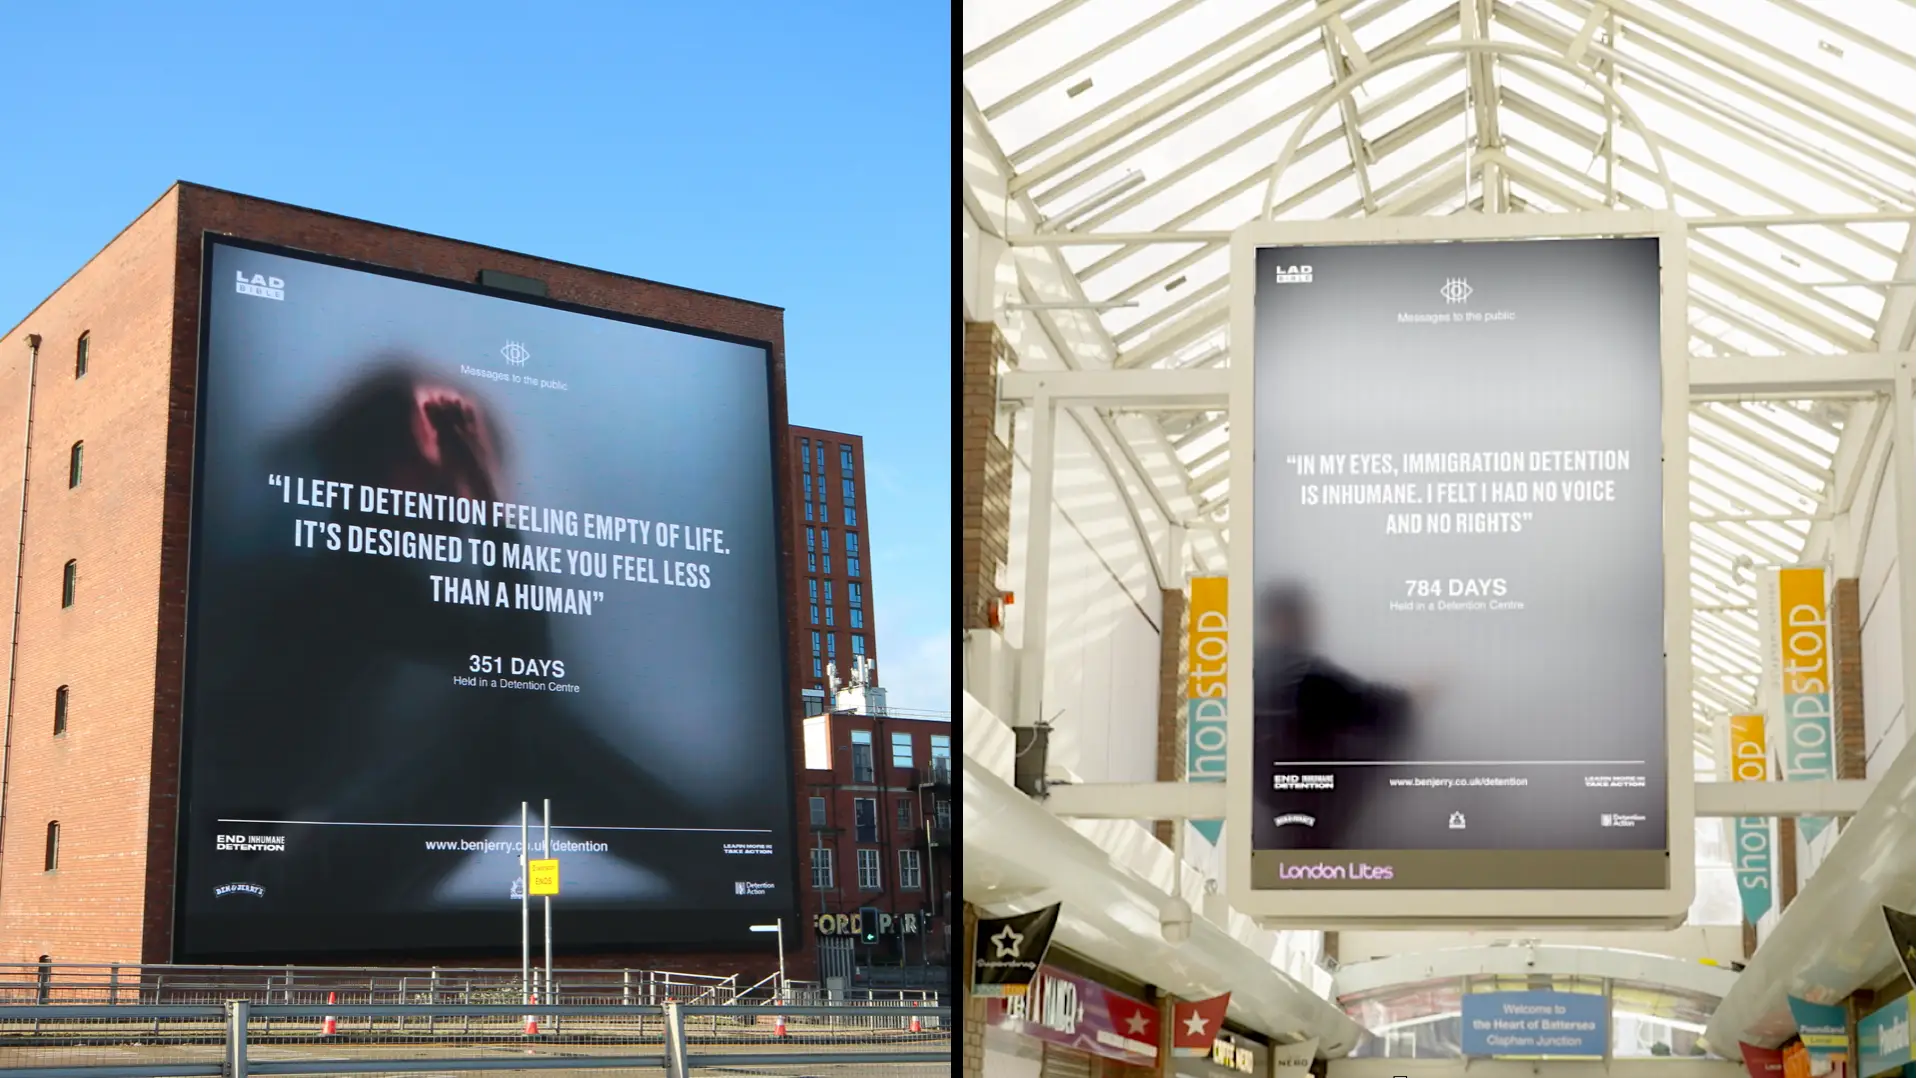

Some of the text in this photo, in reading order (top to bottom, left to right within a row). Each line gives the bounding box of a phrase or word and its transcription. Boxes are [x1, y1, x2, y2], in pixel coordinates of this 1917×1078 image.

[1276, 265, 1313, 274] LAD
[236, 270, 285, 289] LAD
[238, 283, 283, 299] BIBLE
[1397, 311, 1516, 324] Messages to the public
[461, 364, 568, 391] Messages to the public
[1319, 453, 1346, 475] MY
[1350, 453, 1398, 477] EYES,
[1403, 451, 1525, 474] IMMIGRATION
[1529, 450, 1630, 472] DETENTION
[1301, 480, 1616, 505] IS INHUMANE. I FELT I HAD NO VOICE
[297, 477, 354, 511] LEFT
[360, 485, 487, 526] DETENTION
[492, 501, 578, 537] FEELING
[584, 513, 650, 545] EMPTY
[655, 522, 680, 548] OF
[685, 525, 730, 555] LIFE.
[1386, 513, 1422, 535] AND
[1427, 513, 1450, 534] NO
[295, 519, 711, 589] IT’S DESIGNED TO MAKE YOU FEEL LESS
[430, 575, 490, 607] THAN
[495, 582, 509, 608] A
[1405, 578, 1507, 597] 784 DAYS
[1389, 599, 1524, 611] Held in a Detention Centre
[469, 654, 565, 679] 351 DAYS
[453, 676, 580, 693] Held in a Detention Centre
[1783, 604, 1829, 780] hopstop
[1189, 611, 1229, 777] hopstop
[1273, 774, 1299, 783] END
[1389, 777, 1528, 788] www.benjerry.co.uk/detention
[216, 834, 285, 845] END INHUMANE
[216, 843, 285, 852] DETENTION
[425, 838, 609, 854] www.benjerry.c.u/detention
[1279, 862, 1393, 879] London Lites
[746, 882, 775, 890] Detention
[977, 959, 1036, 970] Superdrug
[1503, 1004, 1566, 1015] Welcome to
[1473, 1019, 1596, 1031] the Heart of Battersea
[1486, 1034, 1582, 1047] Clapham Junction
[1278, 1059, 1308, 1067] NERO
